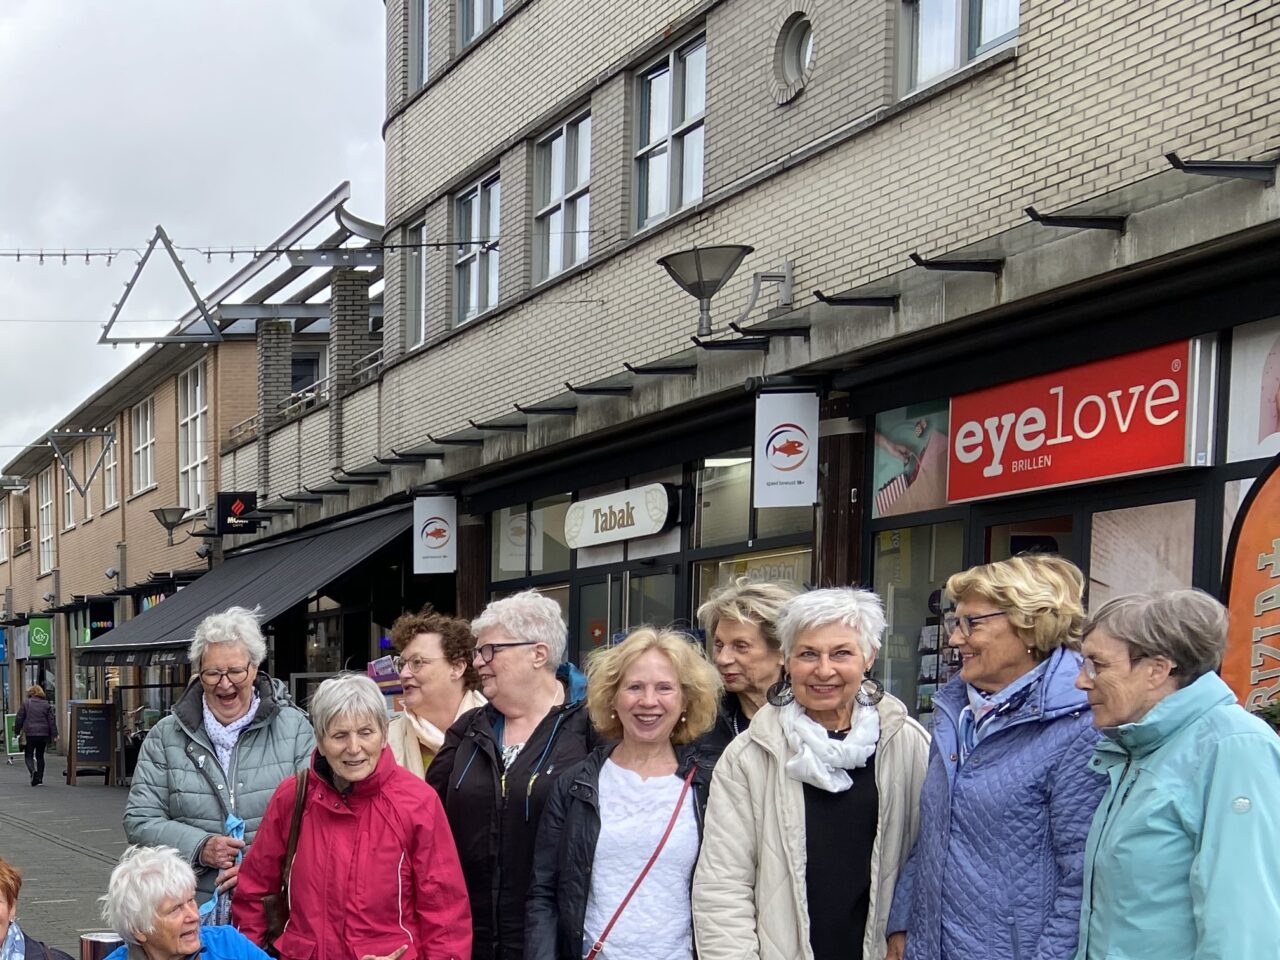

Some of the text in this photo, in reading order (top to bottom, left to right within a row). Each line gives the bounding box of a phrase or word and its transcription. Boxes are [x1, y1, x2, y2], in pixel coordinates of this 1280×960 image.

[955, 379, 1180, 478] eyelove
[1011, 455, 1052, 473] BRILLEN
[592, 501, 636, 533] Tabak
